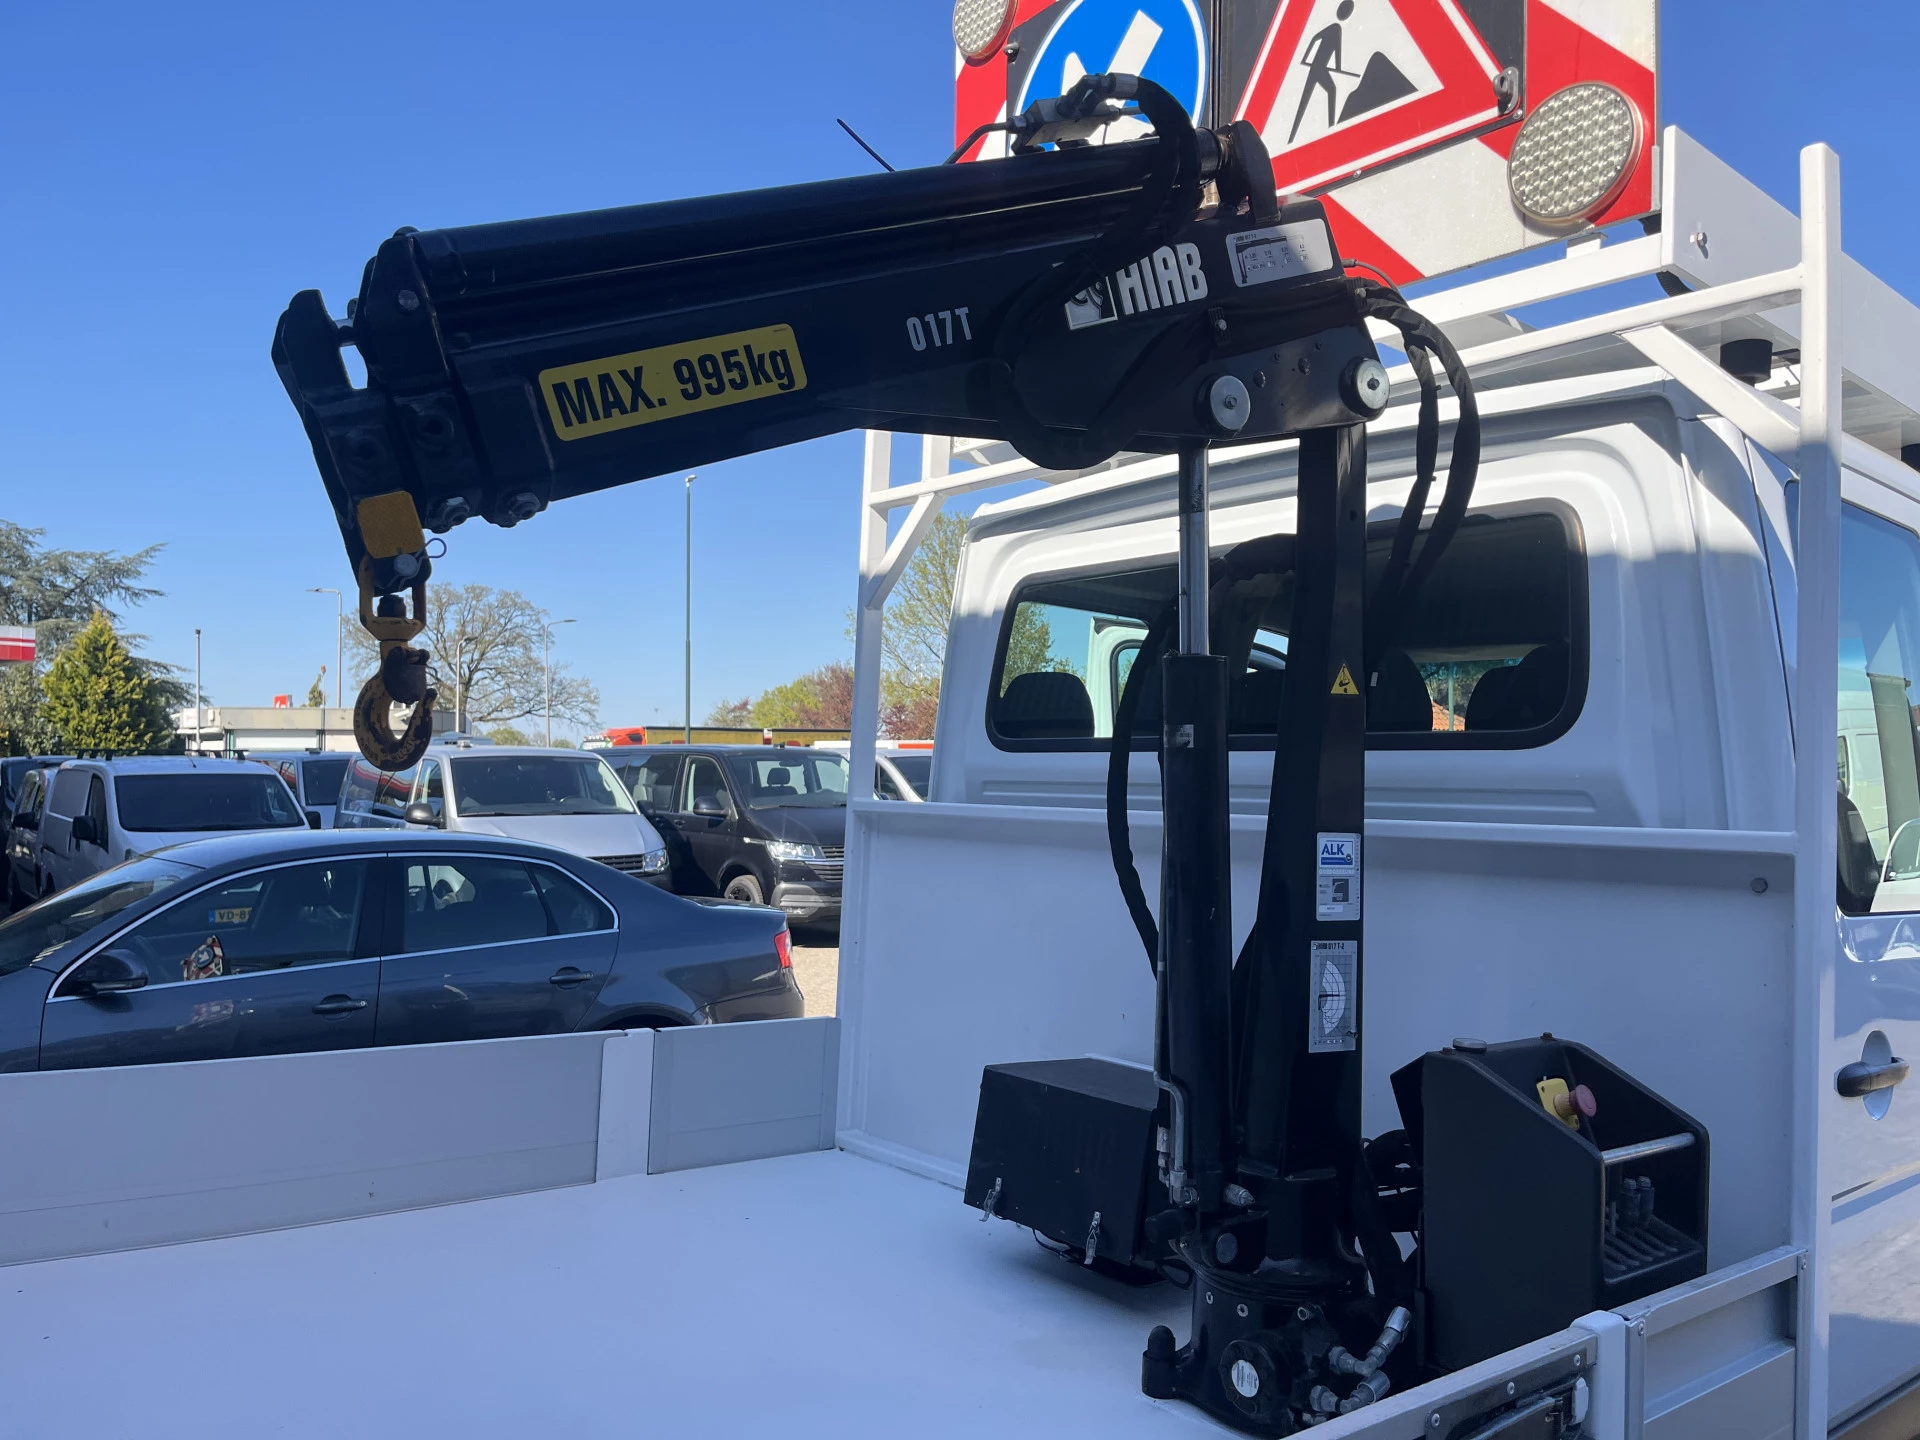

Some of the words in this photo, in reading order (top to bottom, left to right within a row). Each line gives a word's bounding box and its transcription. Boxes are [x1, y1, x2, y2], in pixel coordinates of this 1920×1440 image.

[1116, 242, 1208, 315] HIAB
[906, 306, 972, 351] 017T
[551, 365, 667, 428] MAX.
[673, 344, 796, 401] 995kg
[1321, 843, 1345, 856] ALK
[218, 909, 251, 921] VD-8
